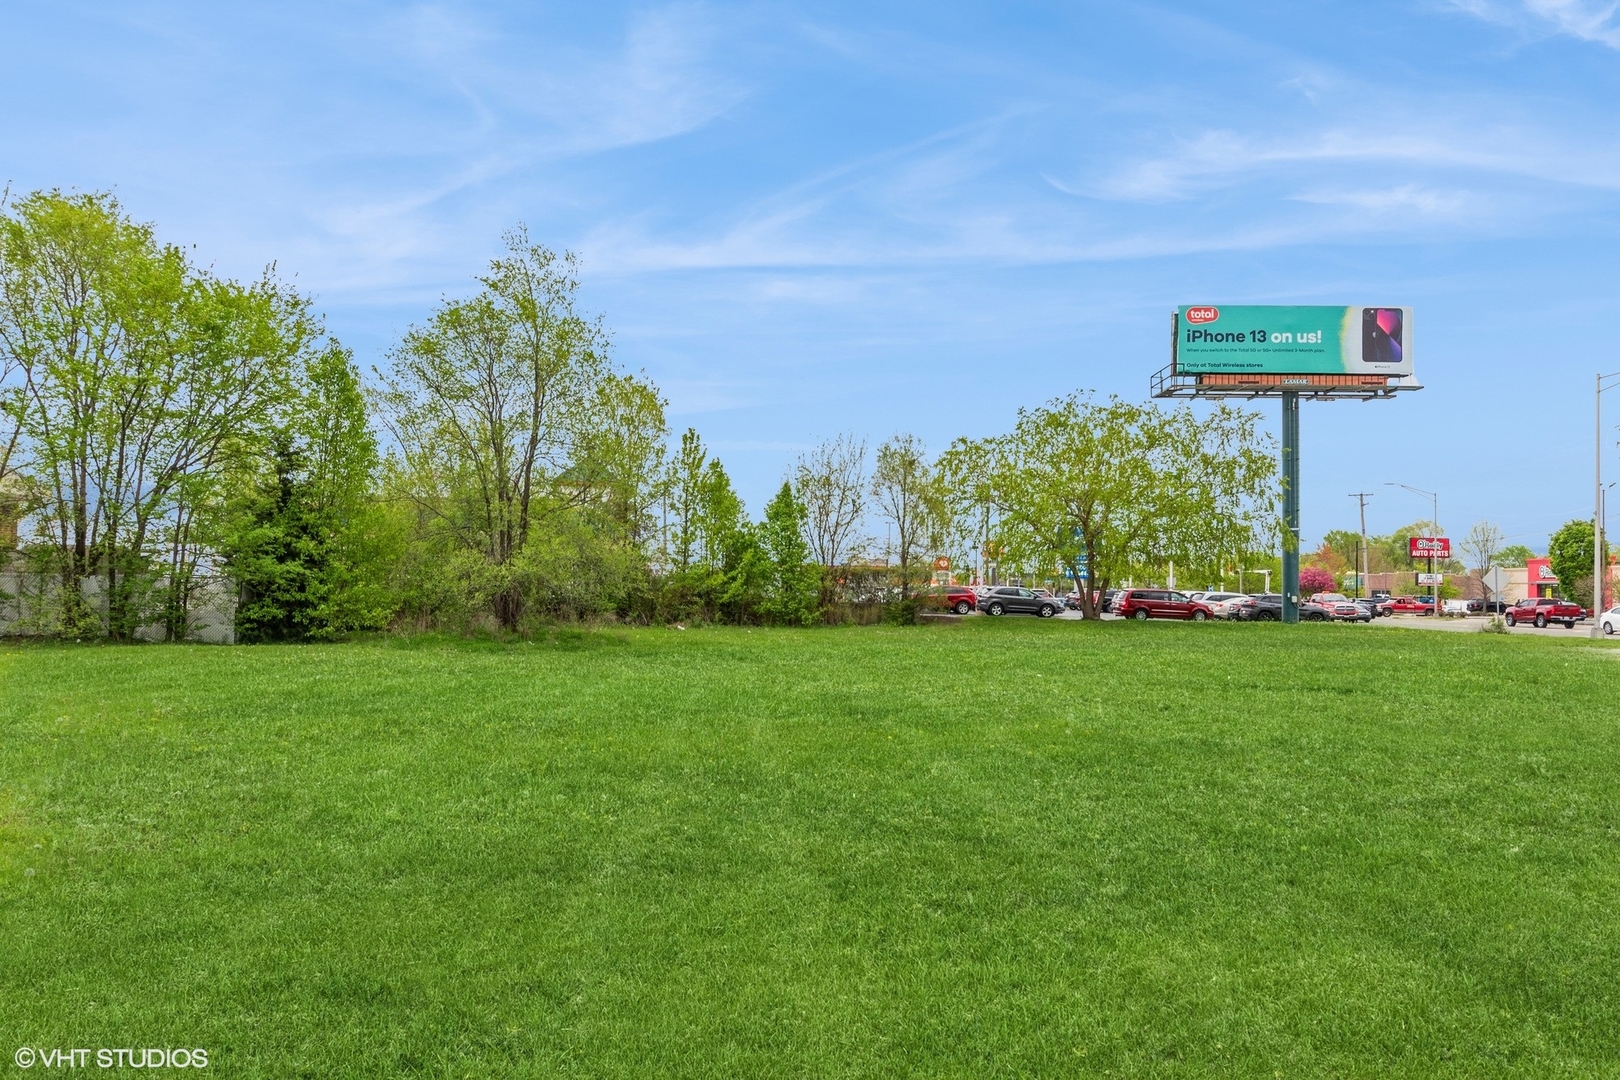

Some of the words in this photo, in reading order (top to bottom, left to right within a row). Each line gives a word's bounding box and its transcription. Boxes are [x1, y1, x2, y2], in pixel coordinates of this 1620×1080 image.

[1190, 309, 1214, 319] total
[1186, 329, 1246, 343] iPhone
[1249, 330, 1267, 343] 13
[1270, 332, 1292, 343] on
[1296, 330, 1322, 343] us!
